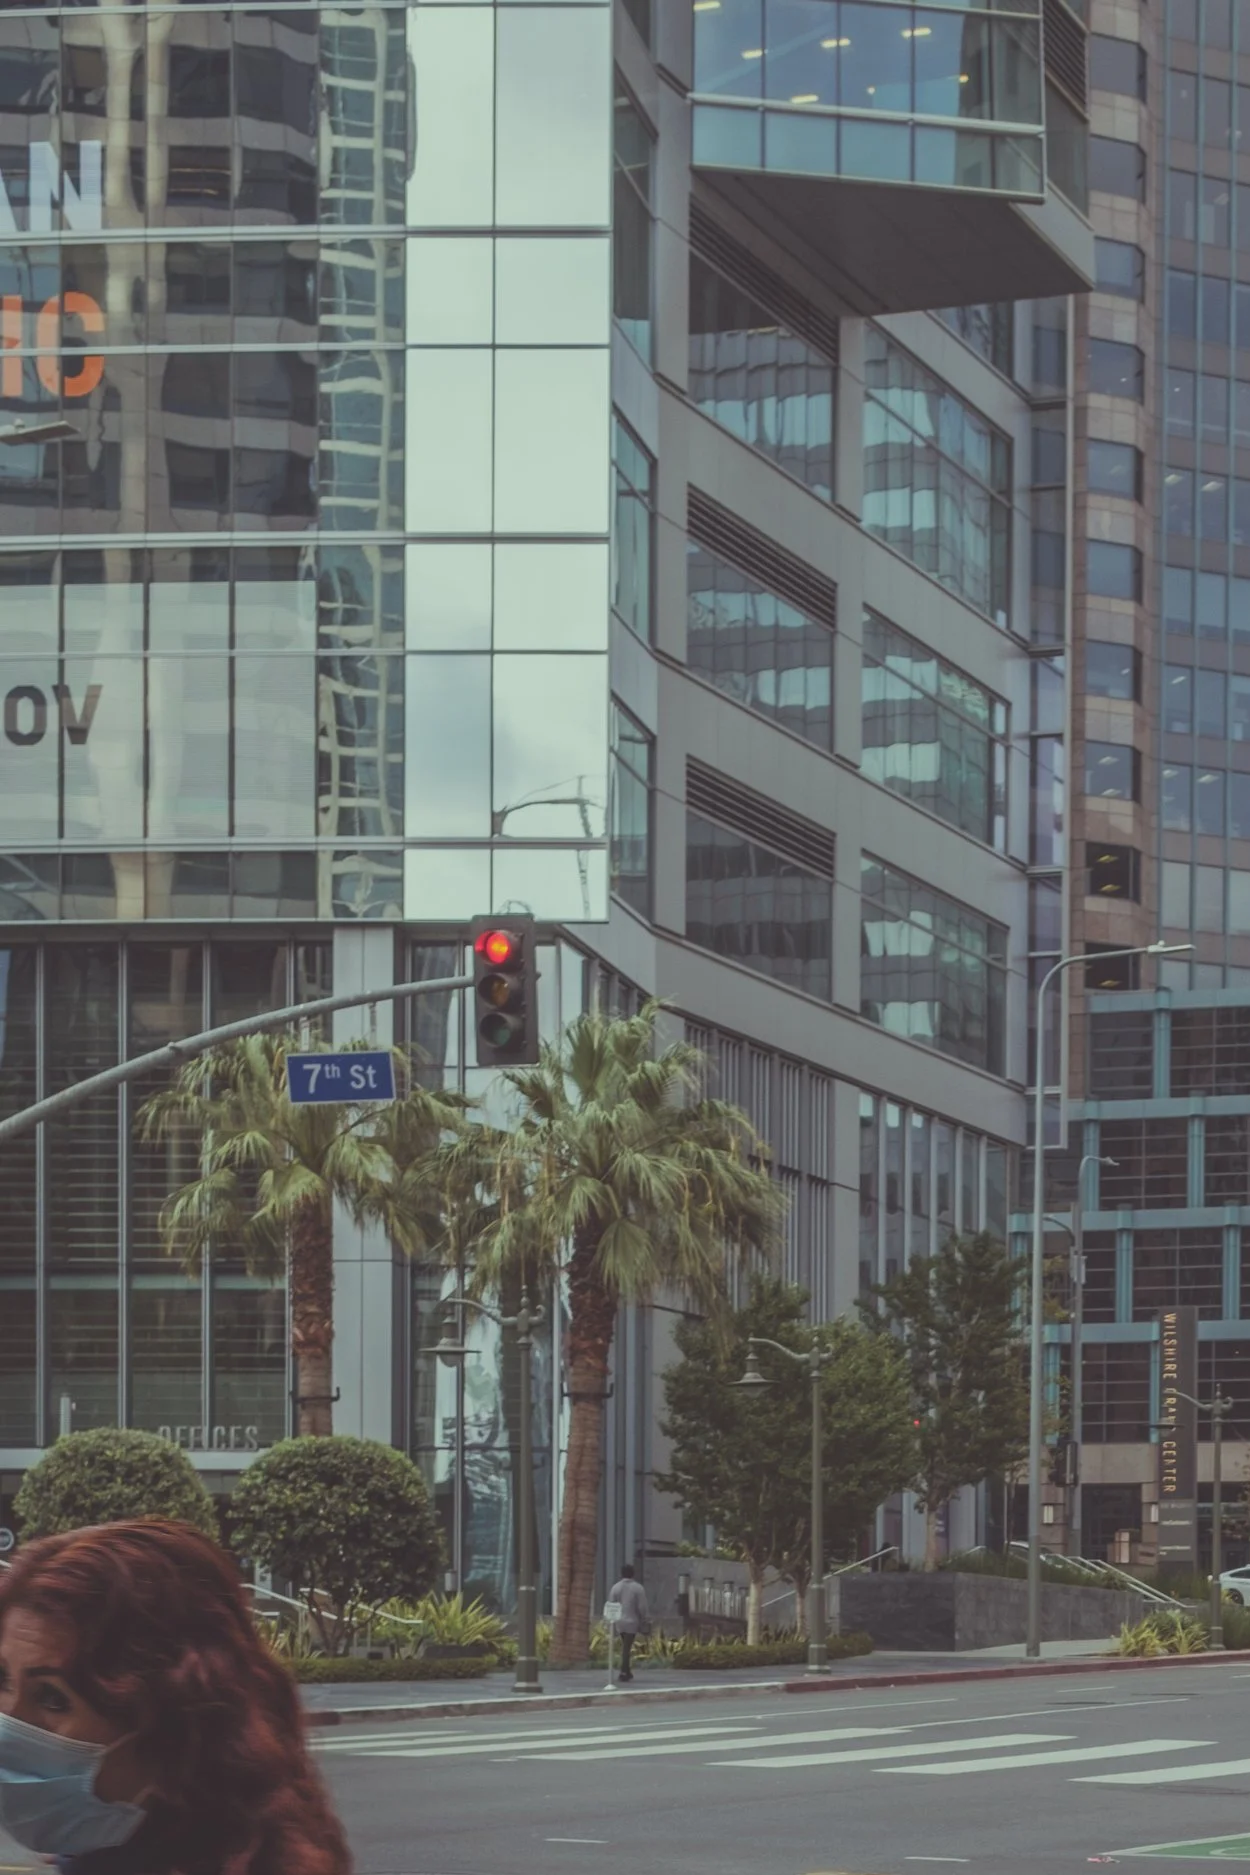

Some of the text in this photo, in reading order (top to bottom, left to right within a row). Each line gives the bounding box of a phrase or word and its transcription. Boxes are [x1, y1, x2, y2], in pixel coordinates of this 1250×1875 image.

[0, 140, 102, 231] N
[4, 684, 104, 746] OV
[302, 1063, 377, 1094] 7th St
[1163, 1313, 1177, 1379] WILSHIRE
[1163, 1441, 1177, 1492] CENTER
